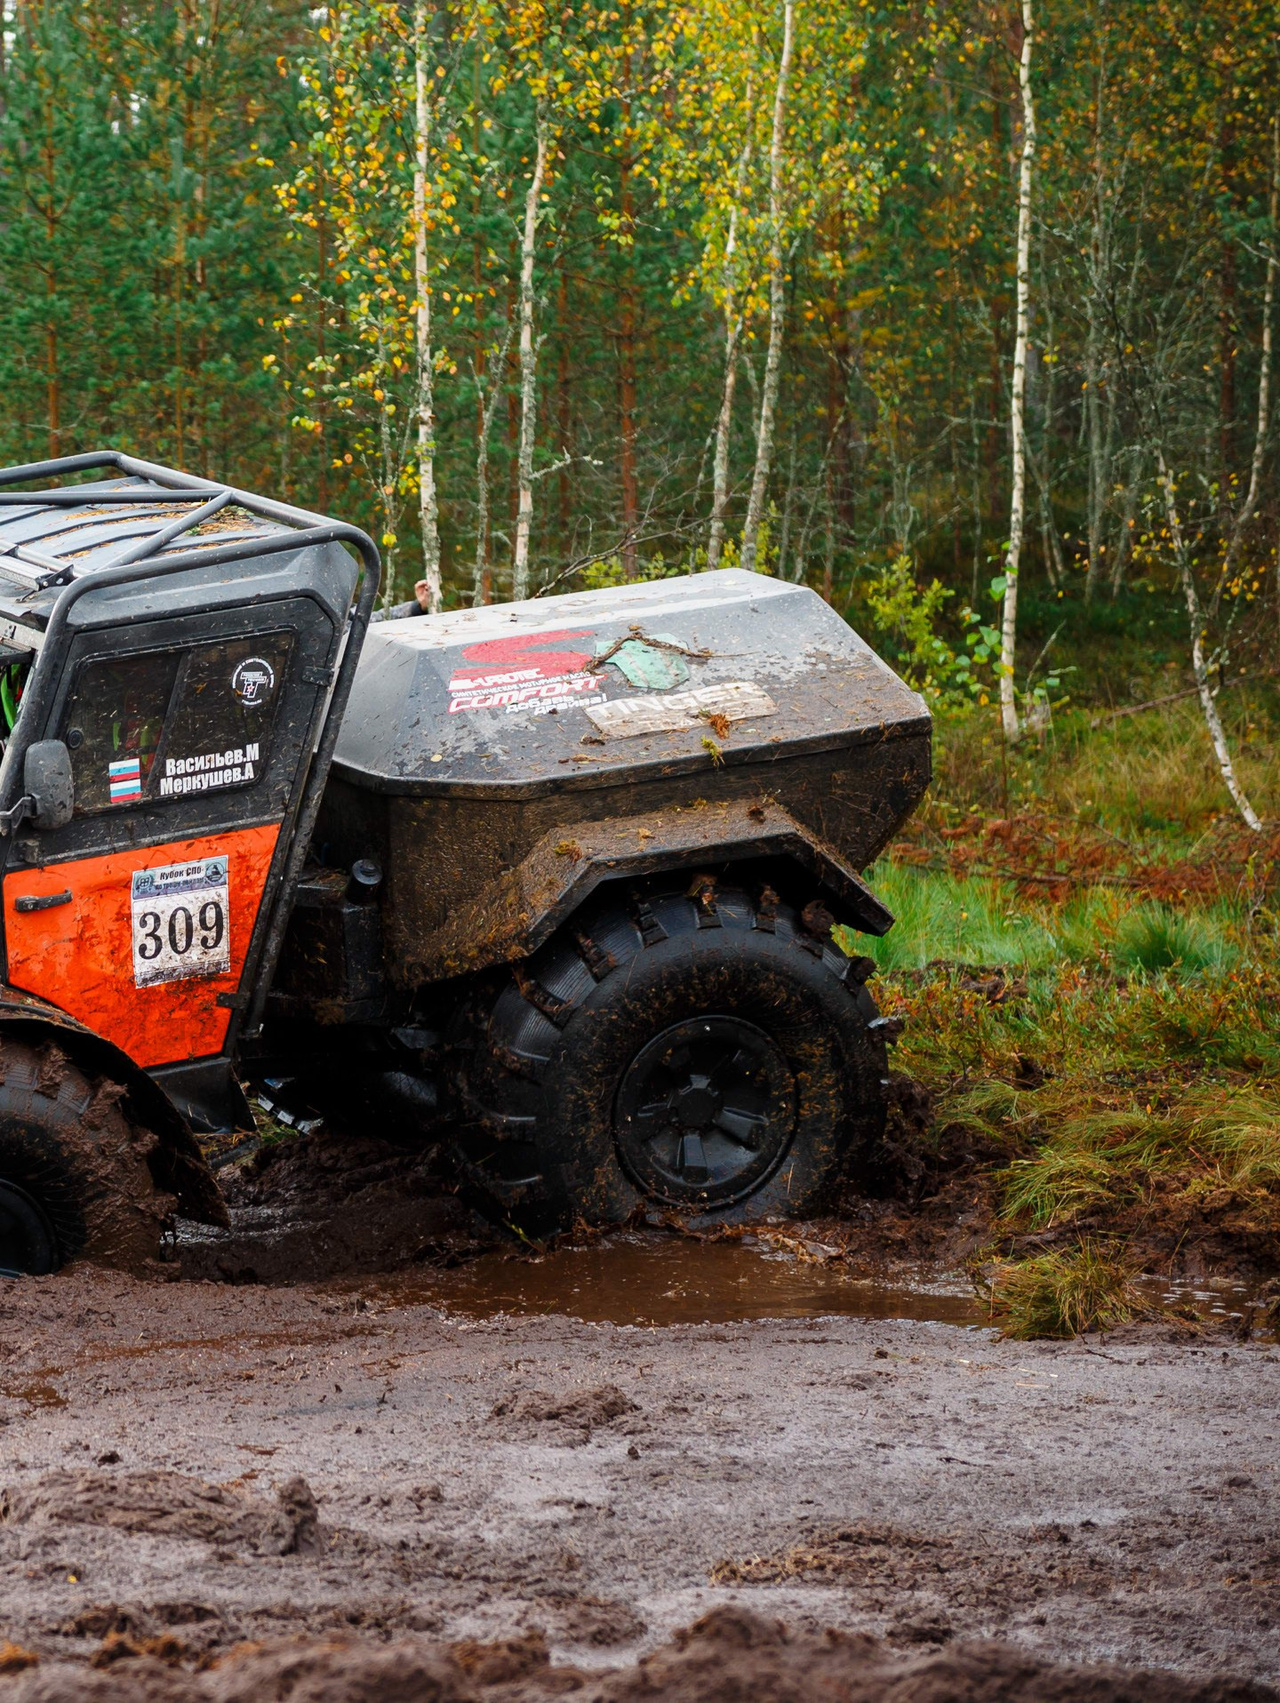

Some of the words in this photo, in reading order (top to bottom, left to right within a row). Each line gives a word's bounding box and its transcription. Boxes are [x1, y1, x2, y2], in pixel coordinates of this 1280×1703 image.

[166, 743, 259, 776] Васильев.М
[160, 765, 254, 796] Меркушев.А
[138, 901, 224, 960] 309
